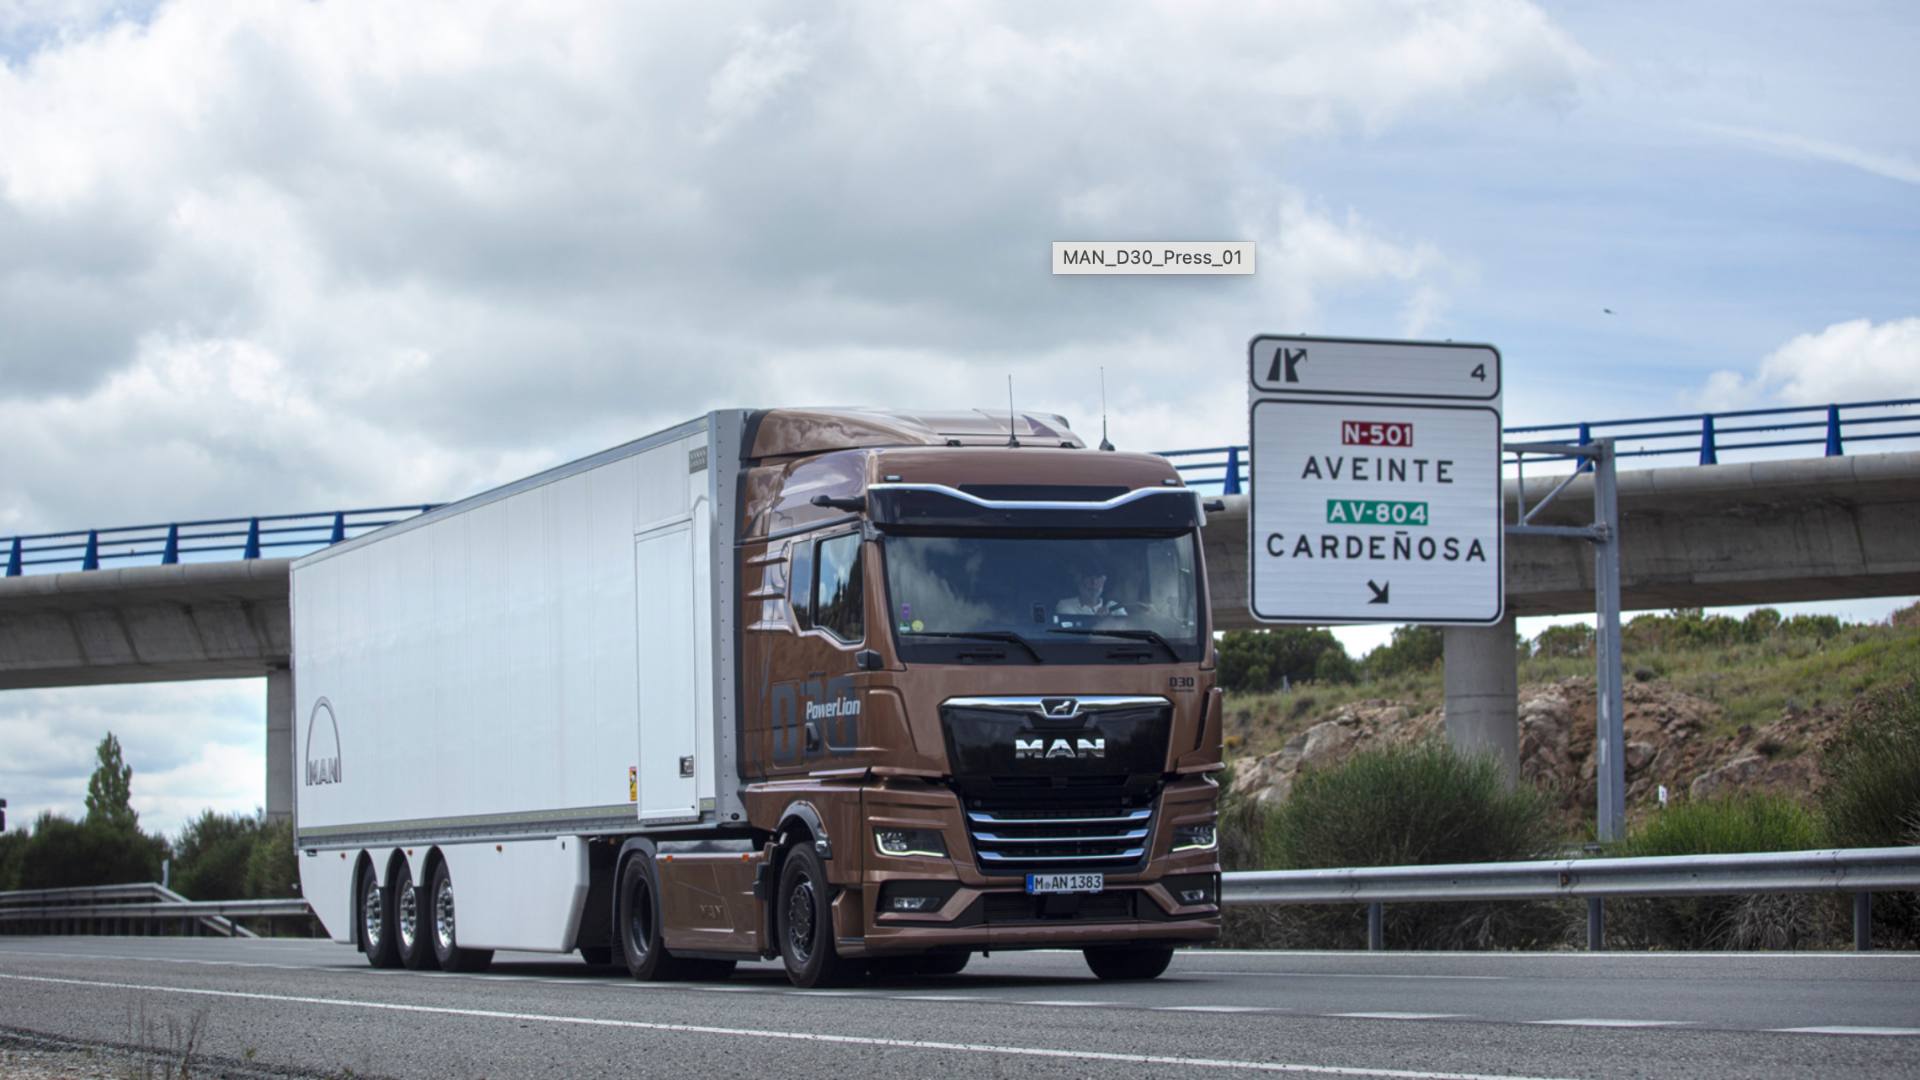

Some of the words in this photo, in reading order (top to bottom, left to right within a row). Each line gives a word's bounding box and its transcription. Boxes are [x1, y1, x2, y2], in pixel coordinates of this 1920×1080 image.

[1471, 363, 1487, 382] 4
[1343, 423, 1413, 446] N-501
[1301, 455, 1454, 484] AVEINTE
[1329, 501, 1427, 524] AV-804
[1266, 530, 1487, 563] CARDEÑOSA
[1169, 676, 1194, 687] D30
[805, 696, 861, 720] PowerLion
[1015, 739, 1105, 759] MAN
[309, 757, 338, 786] MAN
